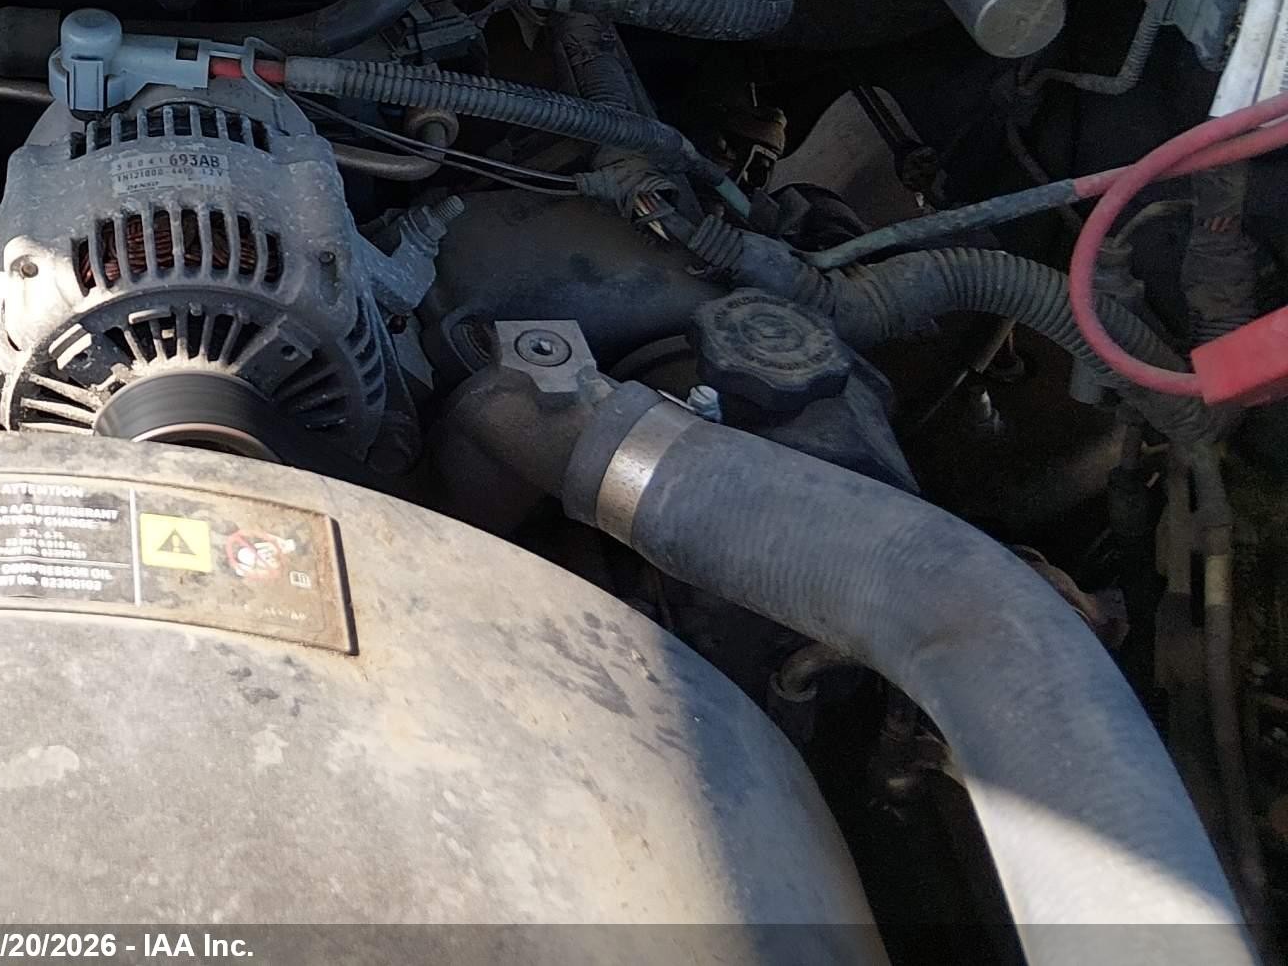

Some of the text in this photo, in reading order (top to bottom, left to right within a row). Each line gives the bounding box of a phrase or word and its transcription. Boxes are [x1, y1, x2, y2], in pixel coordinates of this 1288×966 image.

[168, 153, 221, 168] 693AB
[0, 483, 84, 498] ATTENTION
[35, 505, 120, 520] REFRIGERANT
[1, 562, 89, 578] COMPRESSOR
[90, 567, 114, 581] OIL
